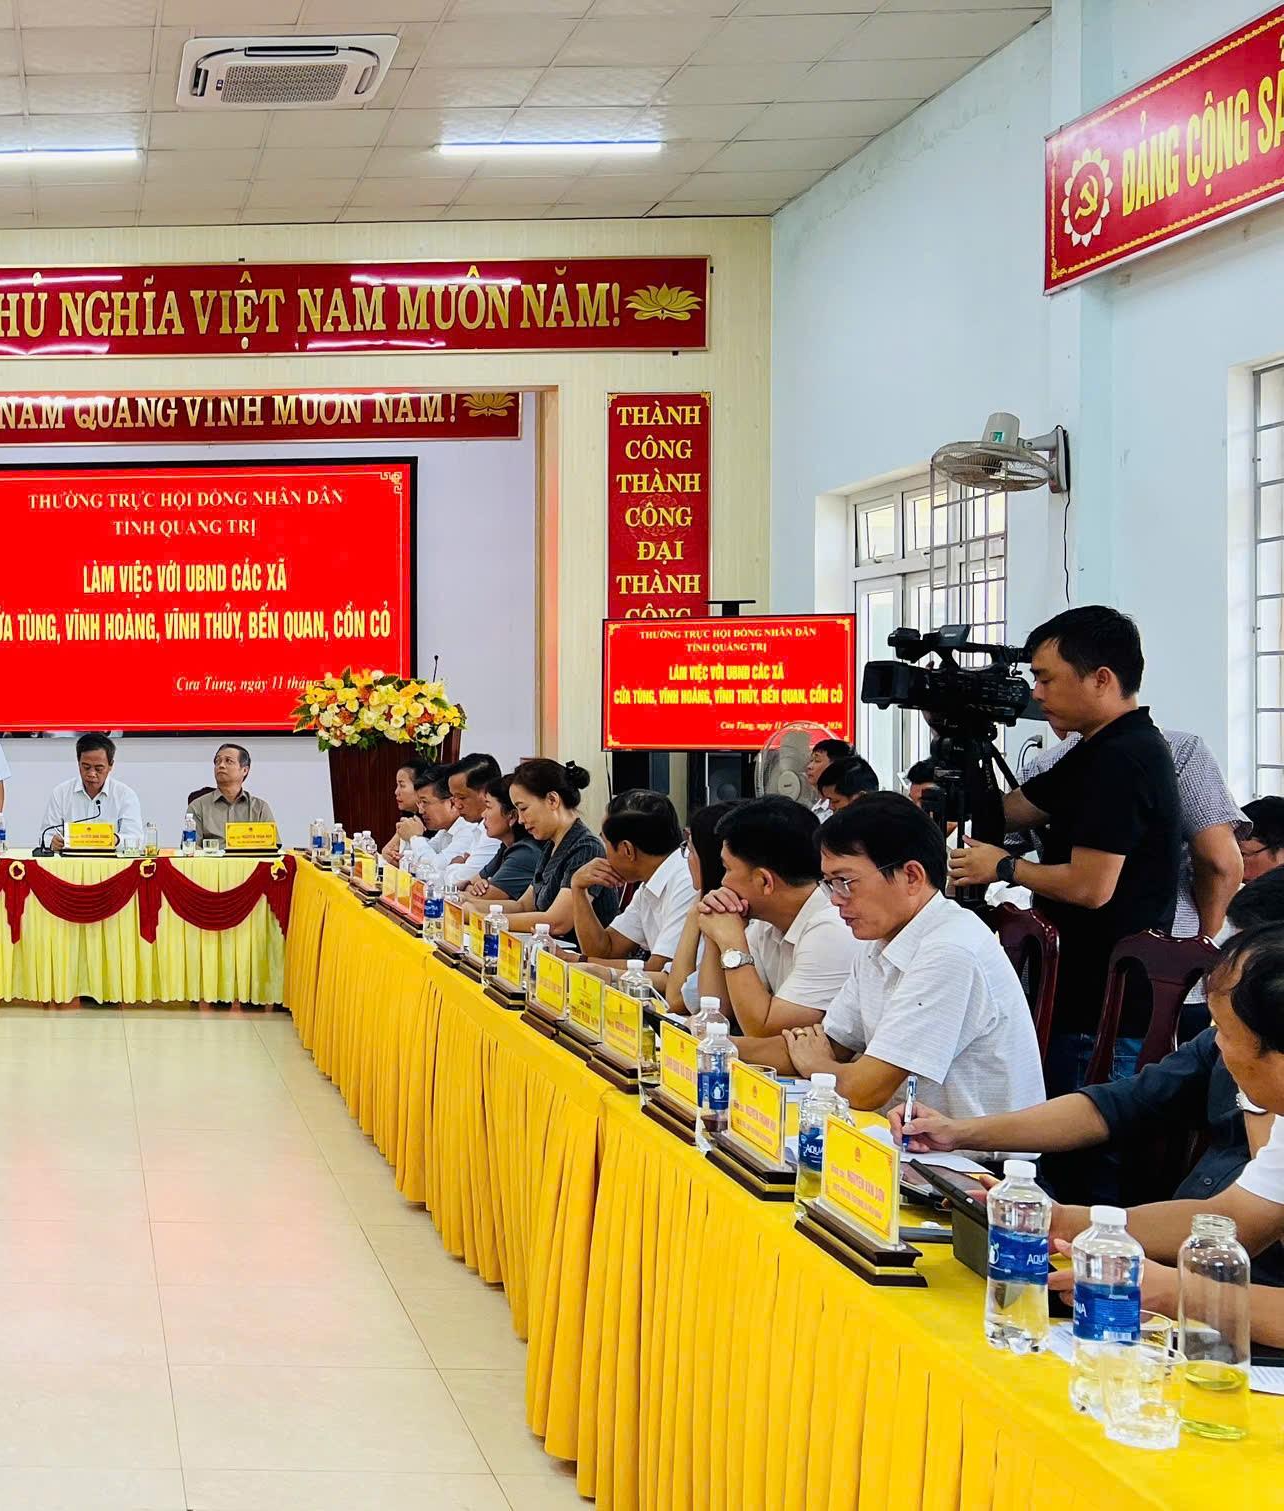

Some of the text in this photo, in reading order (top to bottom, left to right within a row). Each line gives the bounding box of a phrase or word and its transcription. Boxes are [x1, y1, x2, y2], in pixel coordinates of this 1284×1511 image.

[1121, 110, 1181, 217] ĐẢNG
[1186, 90, 1250, 197] CỘNG
[59, 275, 184, 337] NGHĨA
[190, 270, 285, 350] VIỆT
[297, 286, 386, 333] NAM
[398, 265, 515, 330] MUÔN
[519, 267, 621, 328] NĂM!
[74, 396, 178, 430] QUANG
[182, 395, 264, 427] VINH
[617, 400, 701, 425] THÀNH
[625, 434, 692, 460] CÔNG
[617, 467, 701, 493] THÀNH
[625, 502, 692, 527] CÔNG
[637, 541, 683, 565] ĐẠI
[83, 557, 287, 598] LÀM VIỆC VỚI UBND CÁC XÃ
[617, 569, 701, 594] THÀNH
[17, 608, 61, 644] TÙNG,
[65, 607, 101, 640] VĨNH
[105, 607, 160, 643] HOÀNG,
[165, 607, 200, 640] VĨNH
[204, 602, 244, 642] THỦY,
[248, 602, 279, 639] BẾN
[283, 610, 329, 642] QUAN,
[333, 601, 365, 638] CỒN
[370, 600, 391, 637] CỎ
[272, 675, 283, 689] 11
